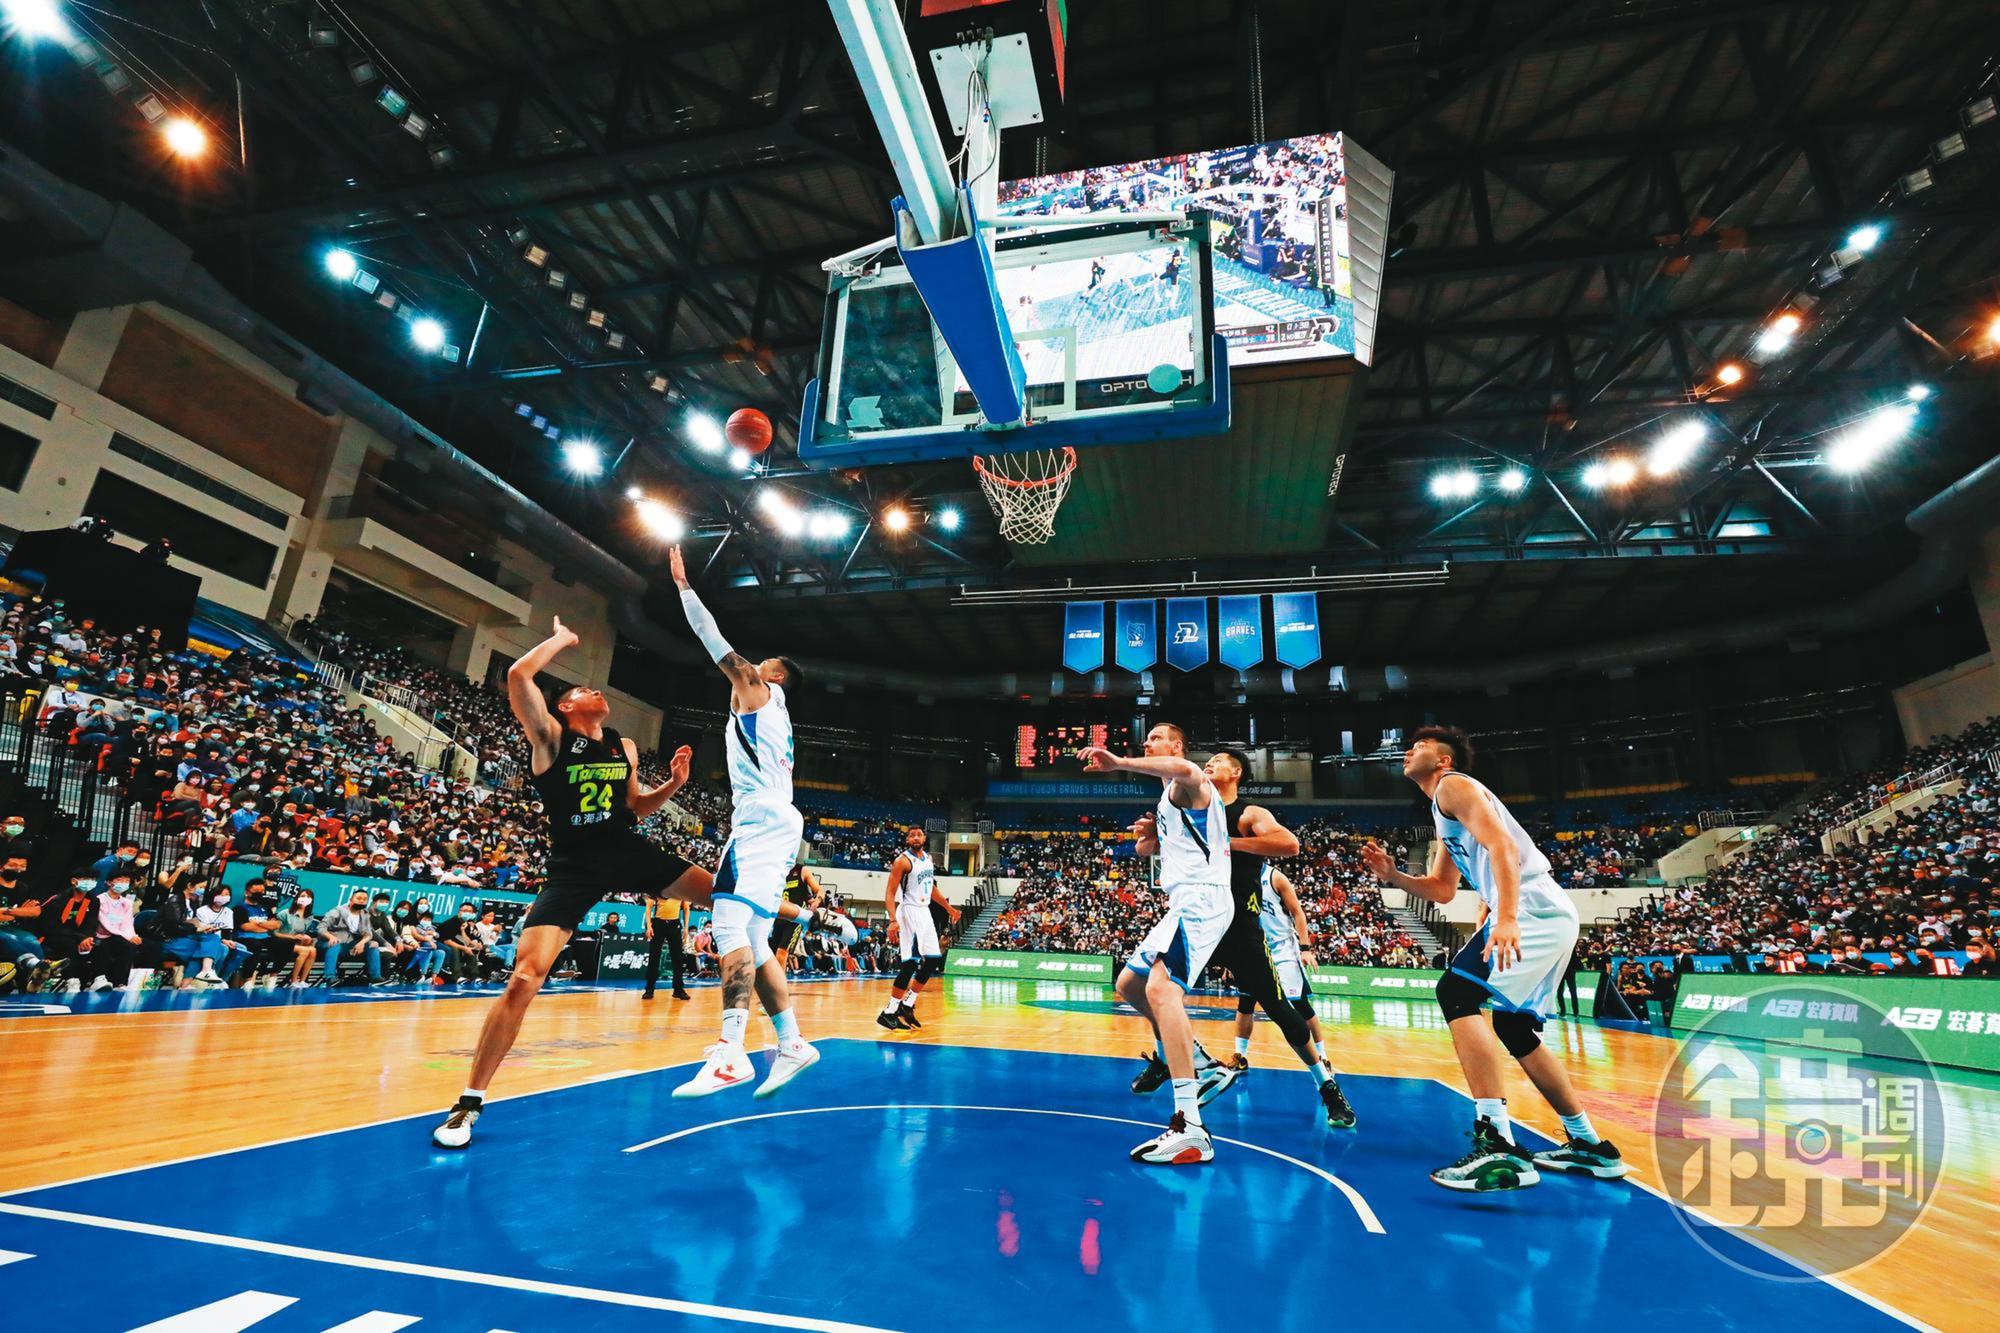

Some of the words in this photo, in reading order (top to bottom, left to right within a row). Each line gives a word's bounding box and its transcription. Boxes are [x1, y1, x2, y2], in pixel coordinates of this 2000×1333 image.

[1101, 375, 1192, 393] OPTOH
[1225, 625, 1256, 638] BRAVES
[580, 782, 613, 813] 24
[1059, 784, 1089, 794] BRAVES
[1093, 784, 1144, 794] BASKETBALL
[1681, 993, 1712, 1010] AEB
[1761, 998, 1804, 1018] AEB
[1880, 1006, 1942, 1031] AEB
